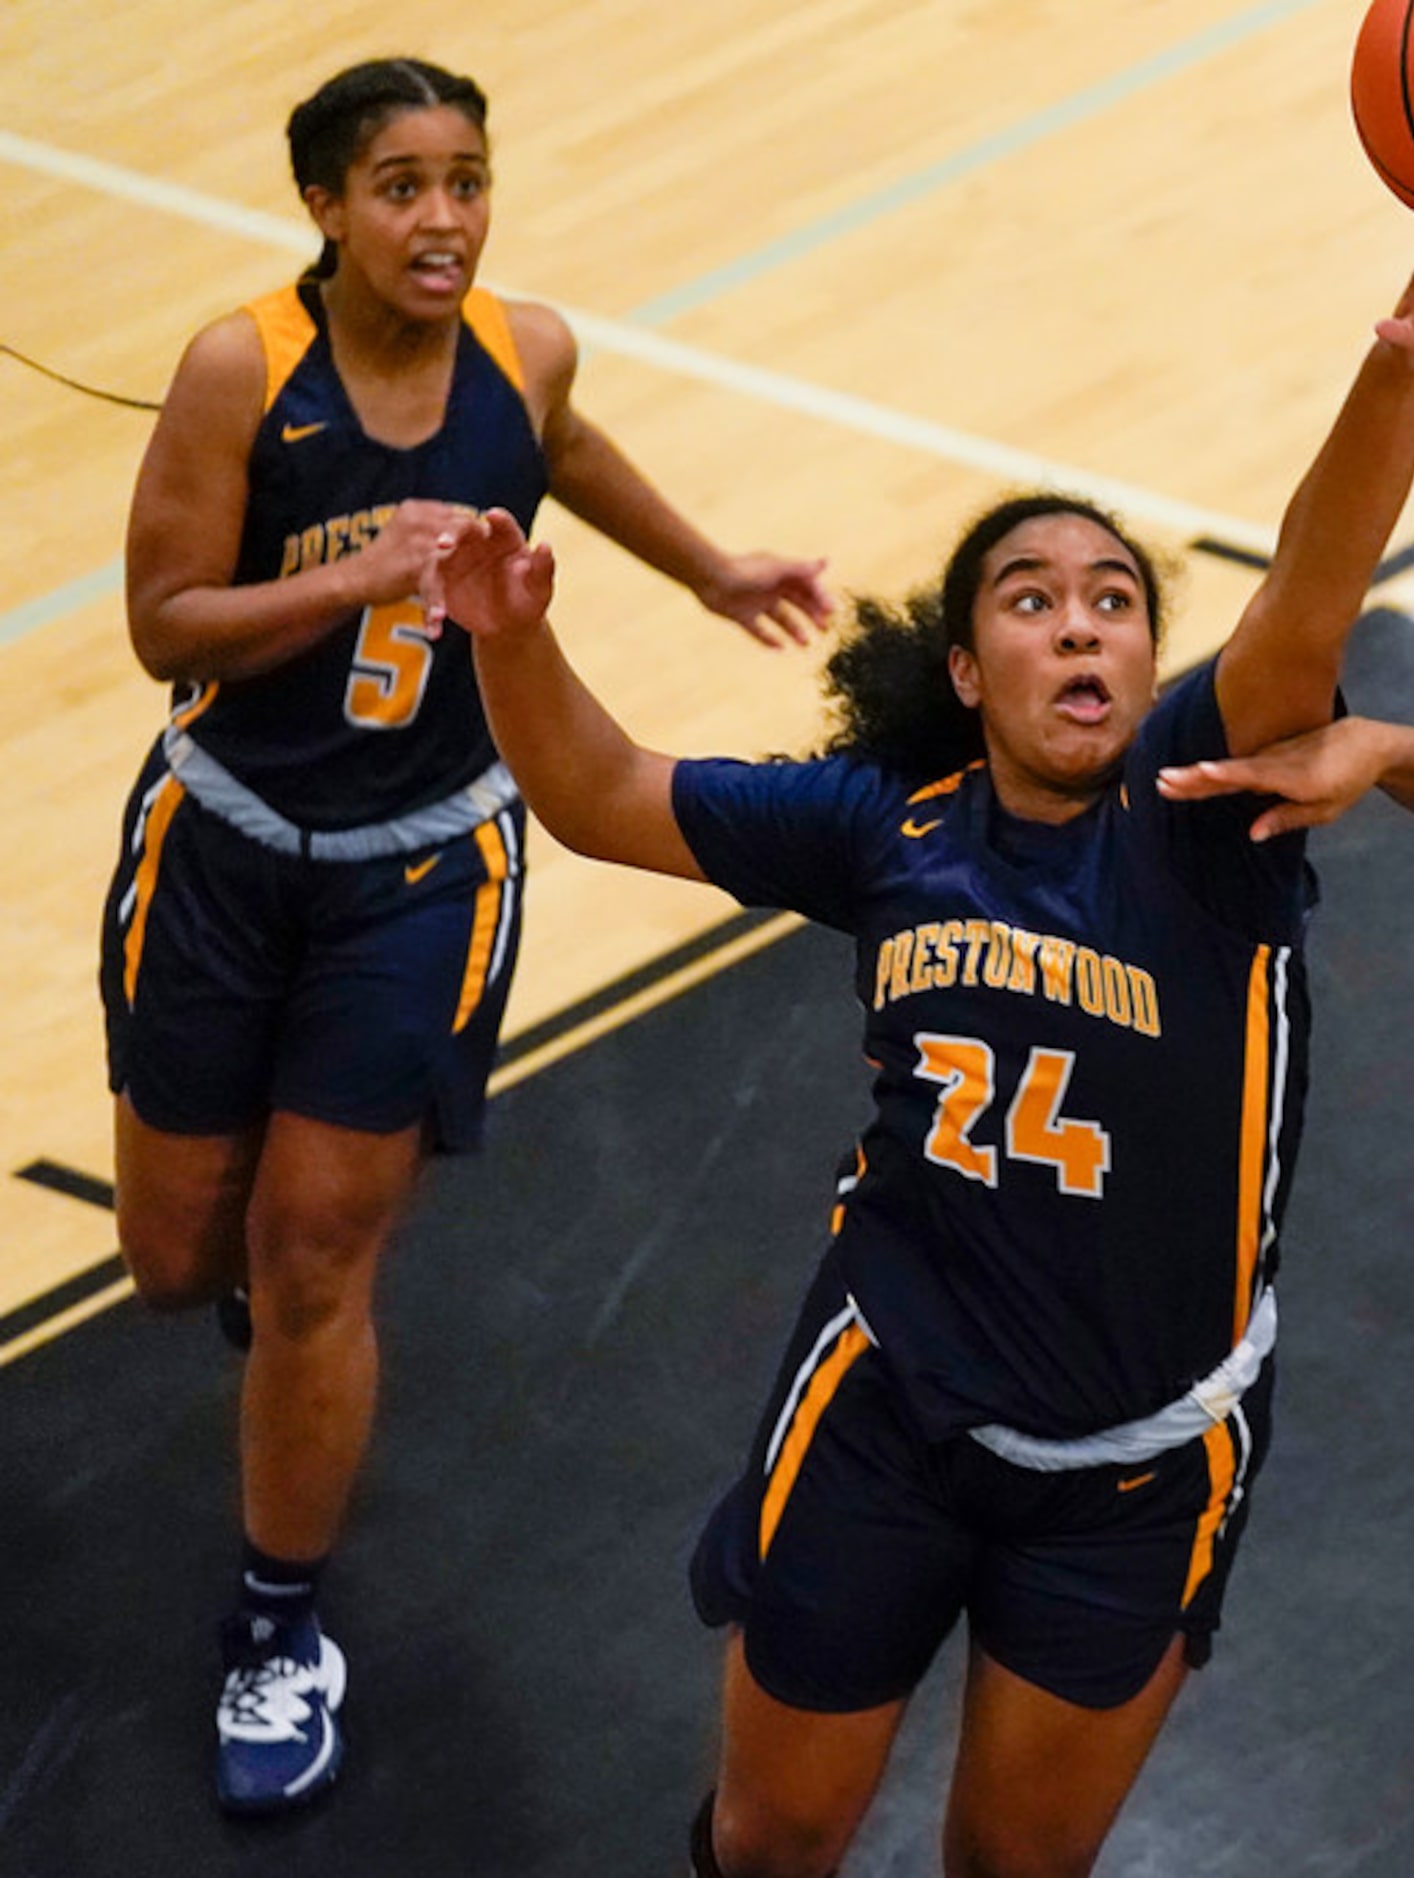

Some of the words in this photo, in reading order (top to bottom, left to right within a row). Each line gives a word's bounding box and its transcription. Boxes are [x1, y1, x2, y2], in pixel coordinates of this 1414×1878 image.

[343, 596, 434, 730] 5
[874, 919, 1161, 1038] PRESTONWOOD
[913, 1031, 1112, 1199] 24
